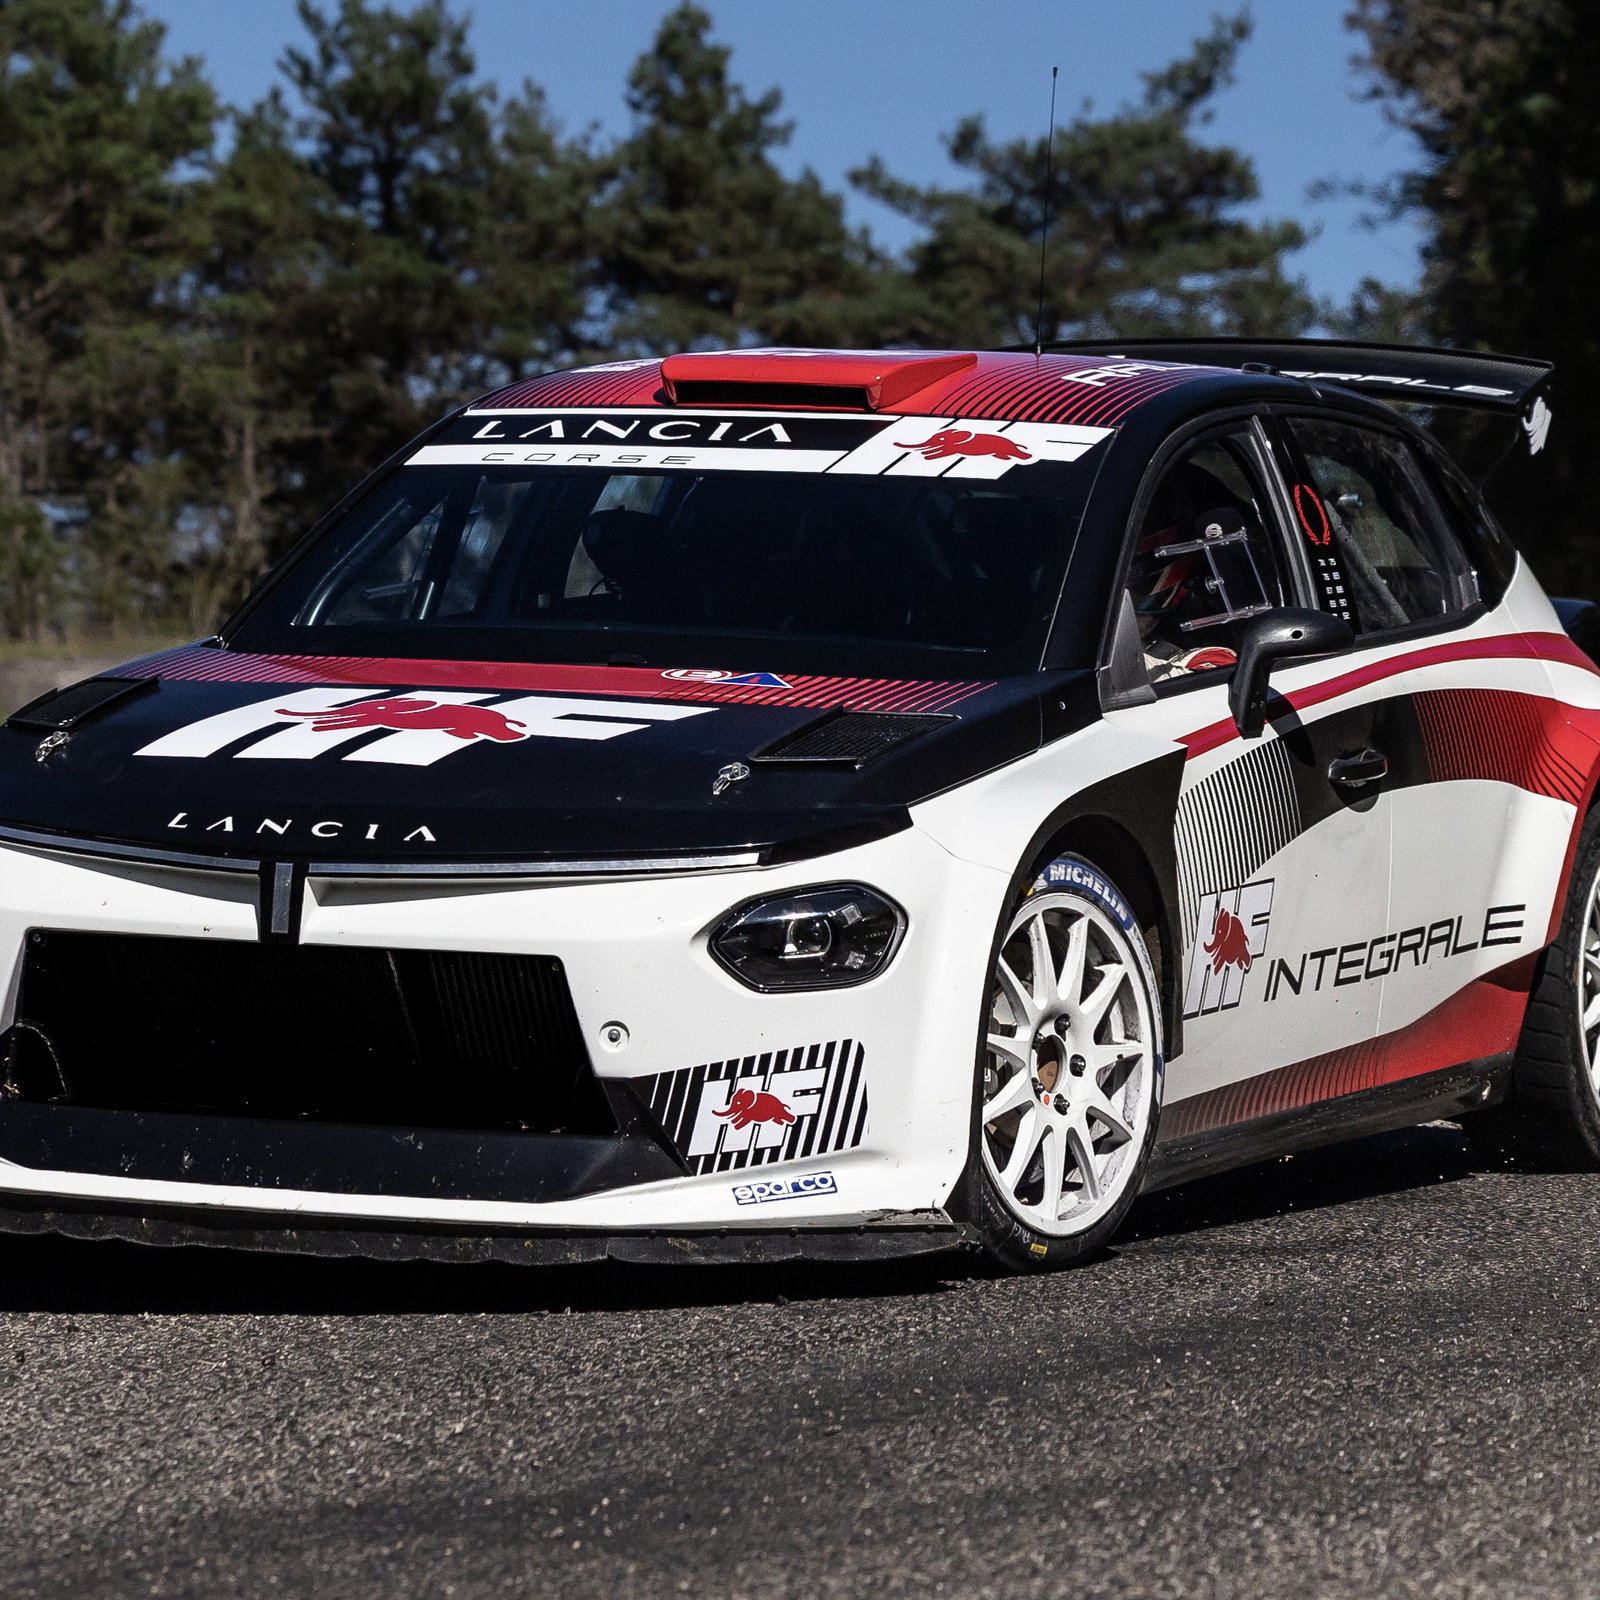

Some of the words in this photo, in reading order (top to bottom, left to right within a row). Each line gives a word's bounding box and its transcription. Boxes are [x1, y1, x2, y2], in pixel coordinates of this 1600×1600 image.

[472, 419, 792, 443] LANCIA
[482, 452, 696, 466] CORSE
[133, 687, 719, 767] HF
[166, 811, 437, 843] LANCIA
[1049, 863, 1128, 922] MICHELIN
[1263, 903, 1526, 1002] INTEGRALE
[687, 1066, 827, 1157] HF
[733, 1172, 837, 1205] sparco
